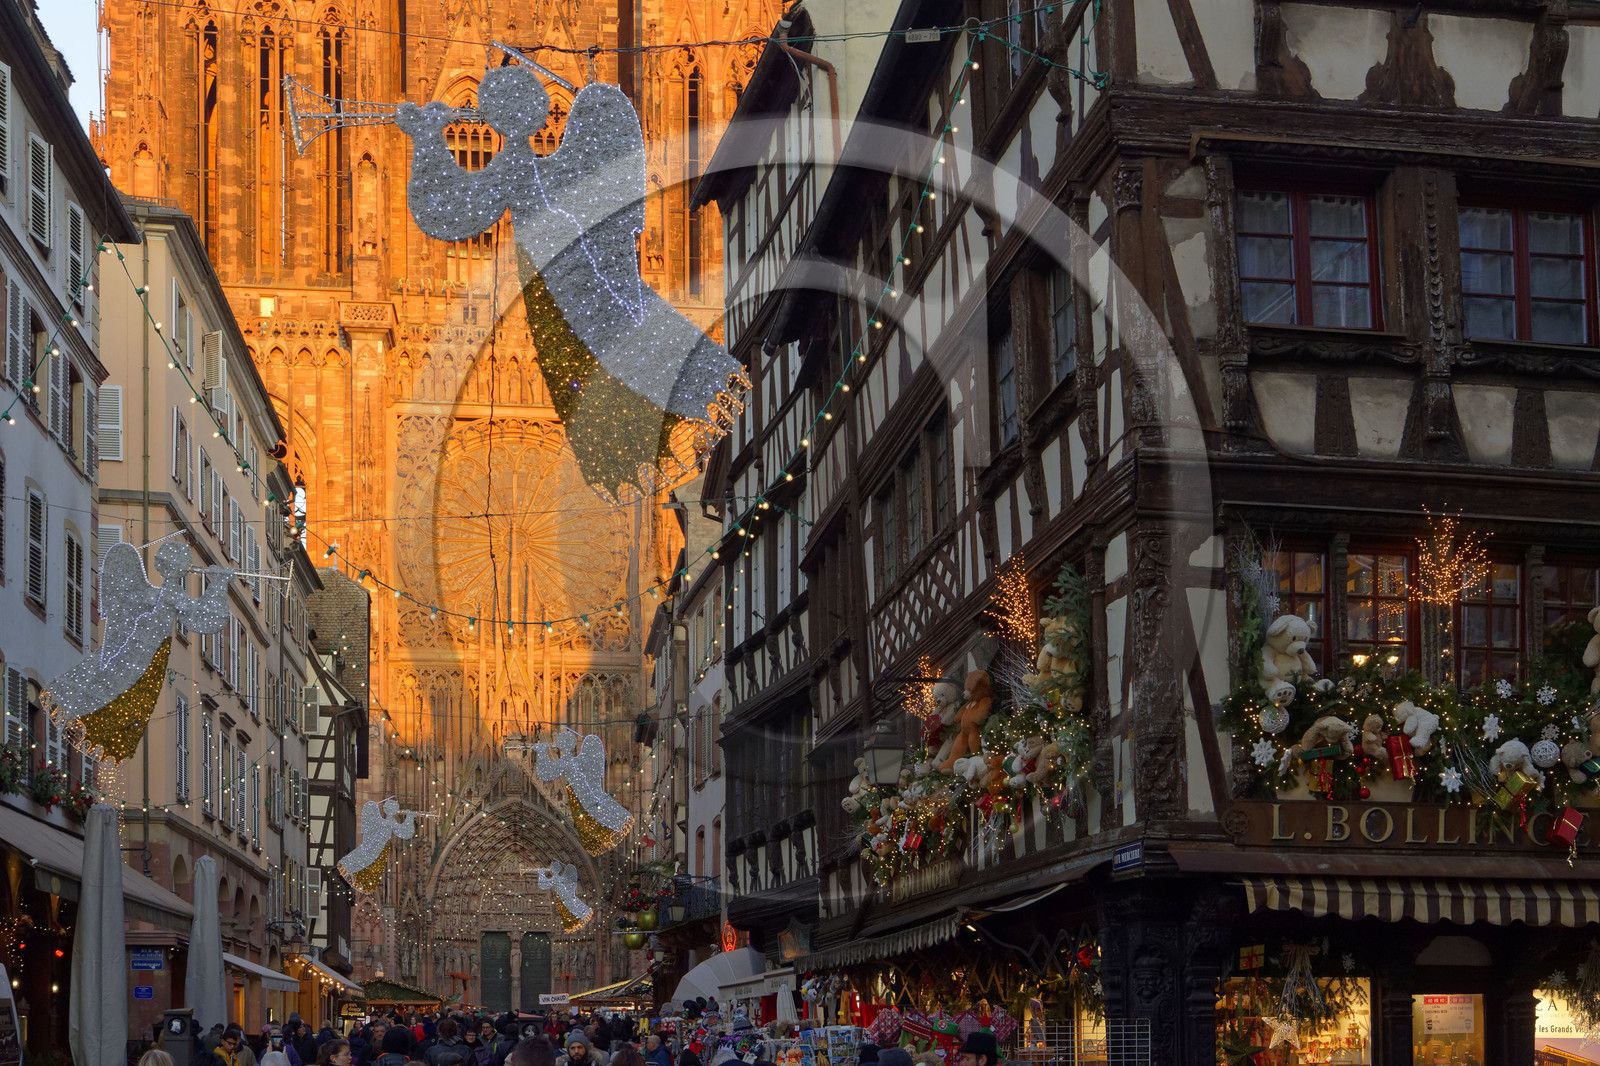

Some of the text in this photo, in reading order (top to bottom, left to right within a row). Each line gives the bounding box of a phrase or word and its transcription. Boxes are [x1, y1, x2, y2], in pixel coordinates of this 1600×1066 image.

[929, 32, 938, 40] 701
[1271, 803, 1600, 847] L. BOLLING
[551, 994, 566, 1003] CHAUD
[1538, 1024, 1549, 1033] les
[1550, 1024, 1573, 1033] Grands
